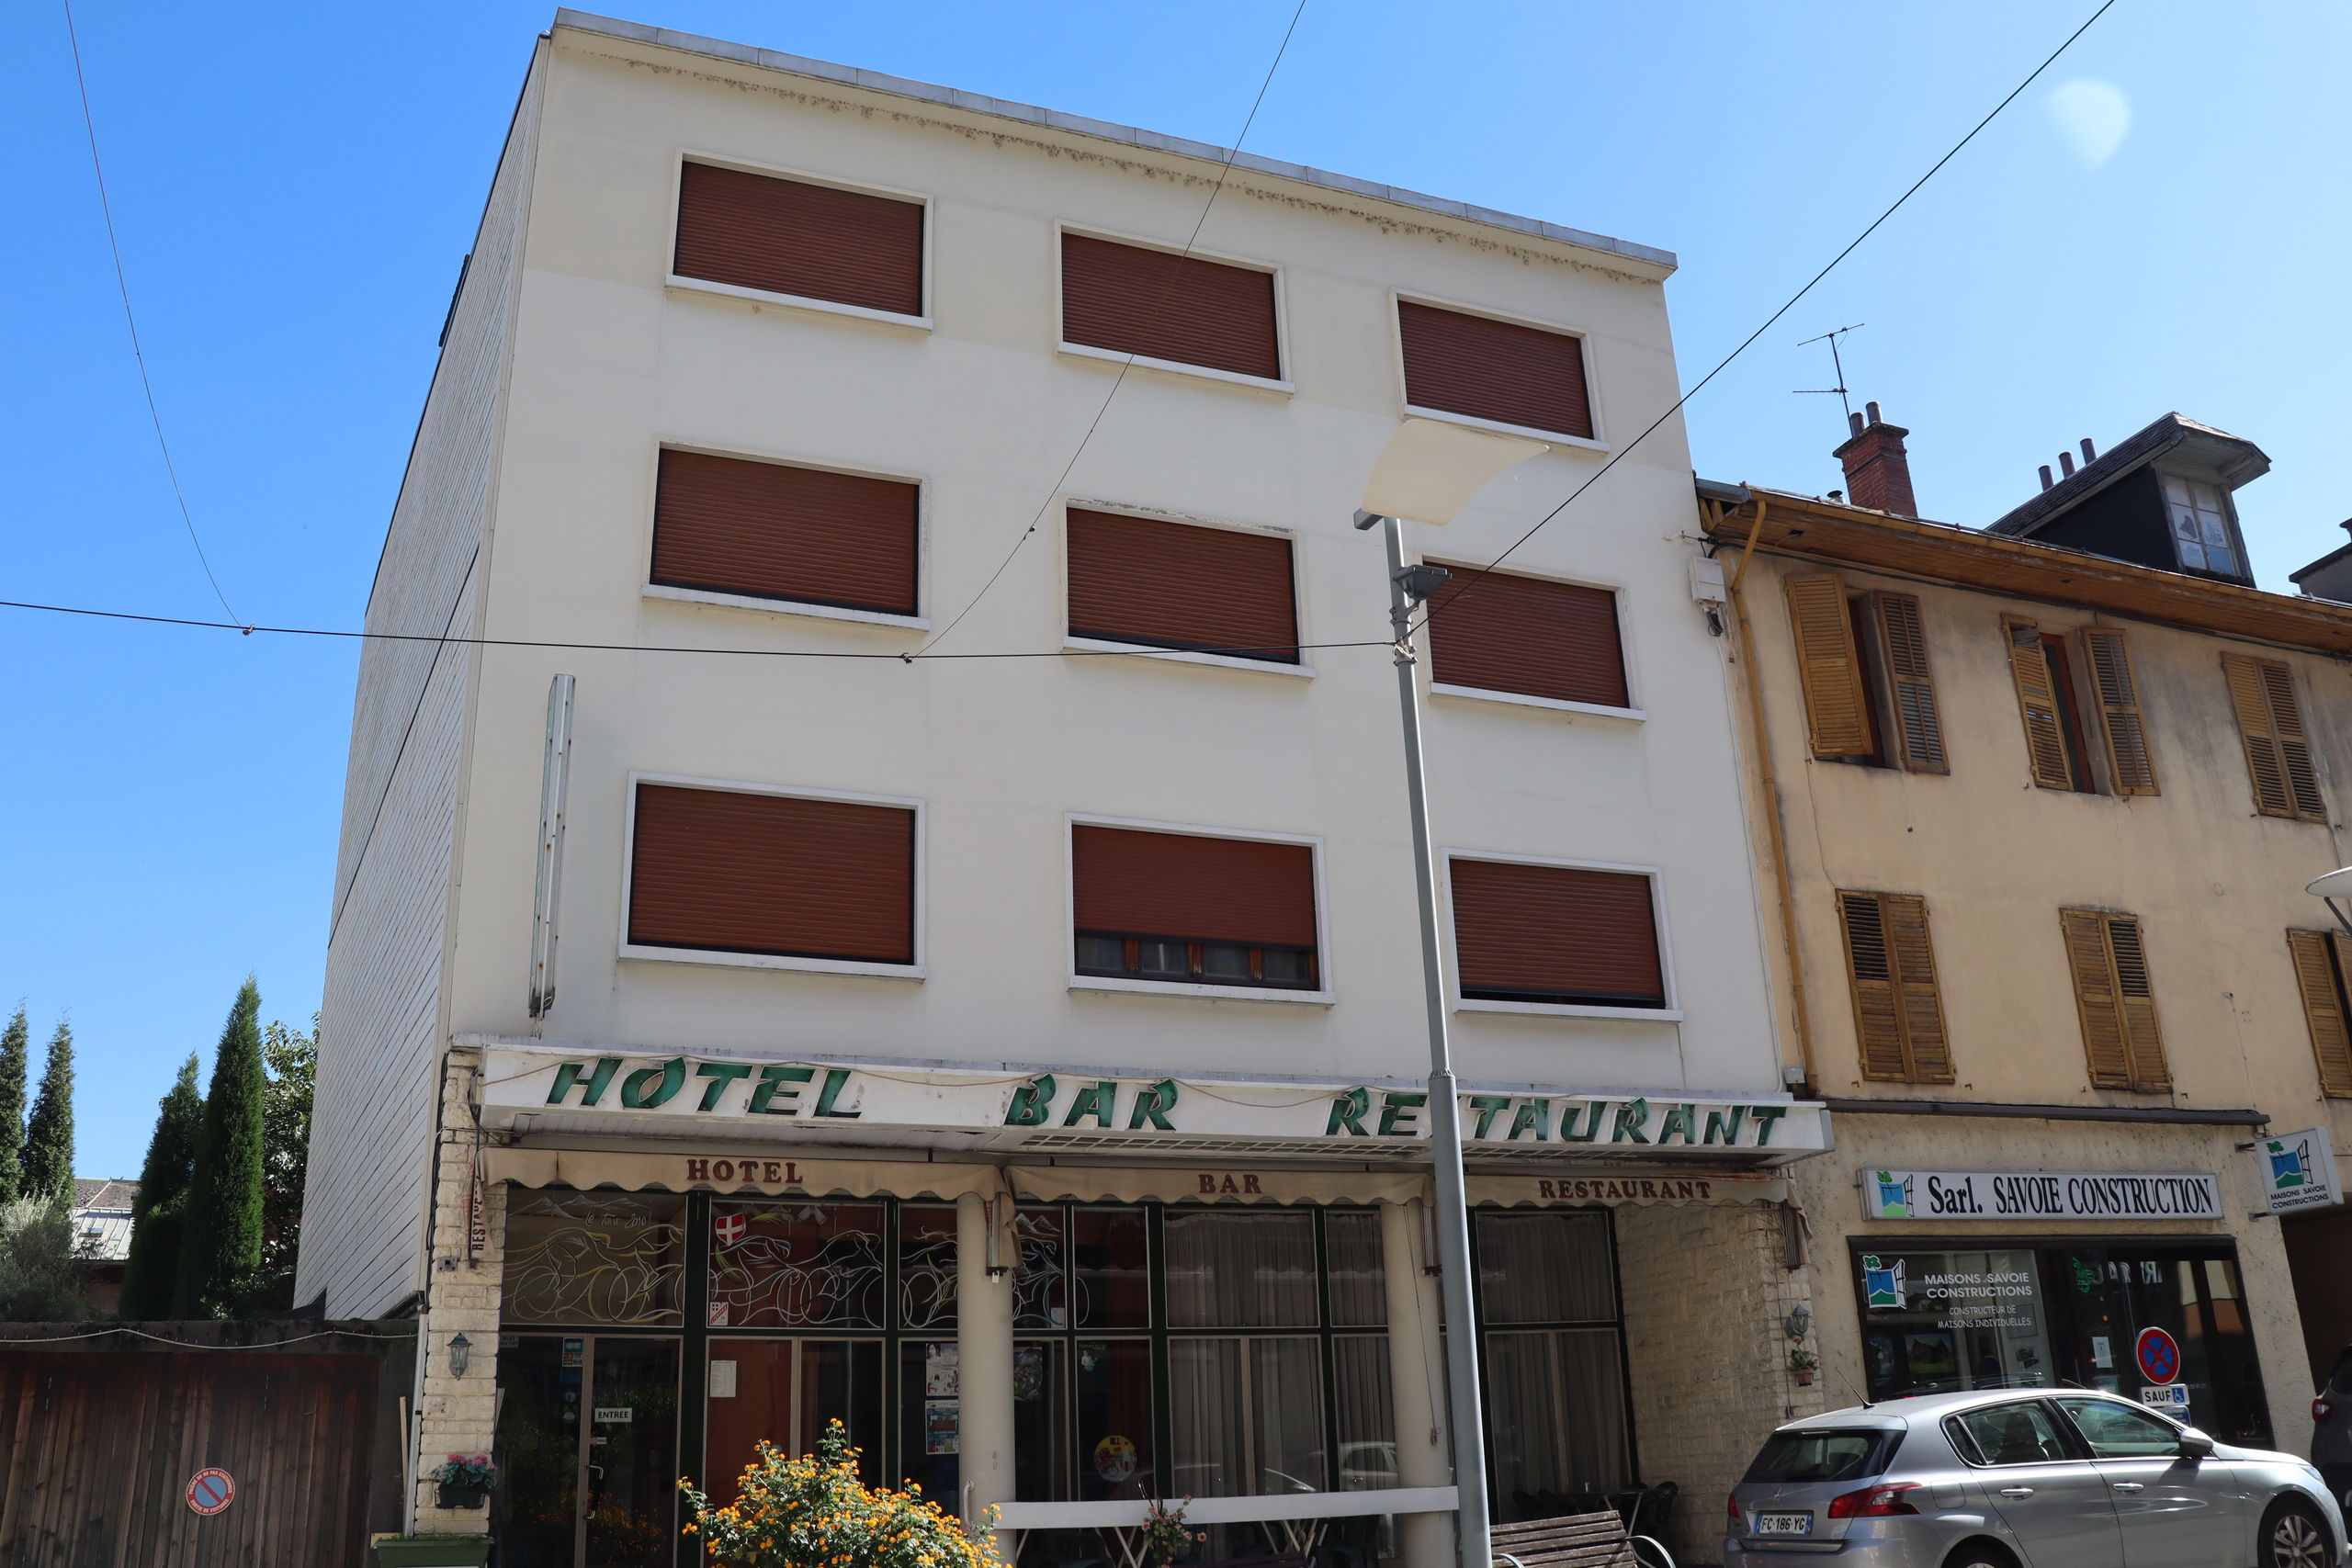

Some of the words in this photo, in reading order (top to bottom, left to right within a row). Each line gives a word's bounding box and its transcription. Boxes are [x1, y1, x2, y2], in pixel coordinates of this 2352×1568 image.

[546, 1056, 863, 1119] HOTEL
[1003, 1072, 1180, 1131] BAR
[1325, 1086, 1787, 1145] RETAURANT
[686, 1158, 803, 1185] HOTEL
[1198, 1173, 1262, 1195] BAR
[1539, 1179, 1712, 1200] RESTAURANT
[2270, 1189, 2301, 1201] MAISONS
[2302, 1184, 2326, 1195] SAVOIE
[1928, 1176, 1983, 1214] Sarl.
[1993, 1176, 2064, 1213] SAVOIE
[2067, 1176, 2214, 1214] CONSTRUCTION
[2272, 1193, 2329, 1210] CONSTRUCTIONS
[625, 1213, 647, 1229] 2010
[1924, 1273, 1981, 1285] MAISONS
[1987, 1272, 2030, 1283] SAVOIE
[1926, 1285, 2032, 1299] CONSTRUCTIONS
[1949, 1305, 2006, 1315] CONSTRUCTEUR
[2007, 1305, 2016, 1314] DE
[1938, 1319, 1974, 1329] MAISONS
[1975, 1317, 2031, 1328] INDIVIDUELLES
[2144, 1390, 2171, 1402] SAUF
